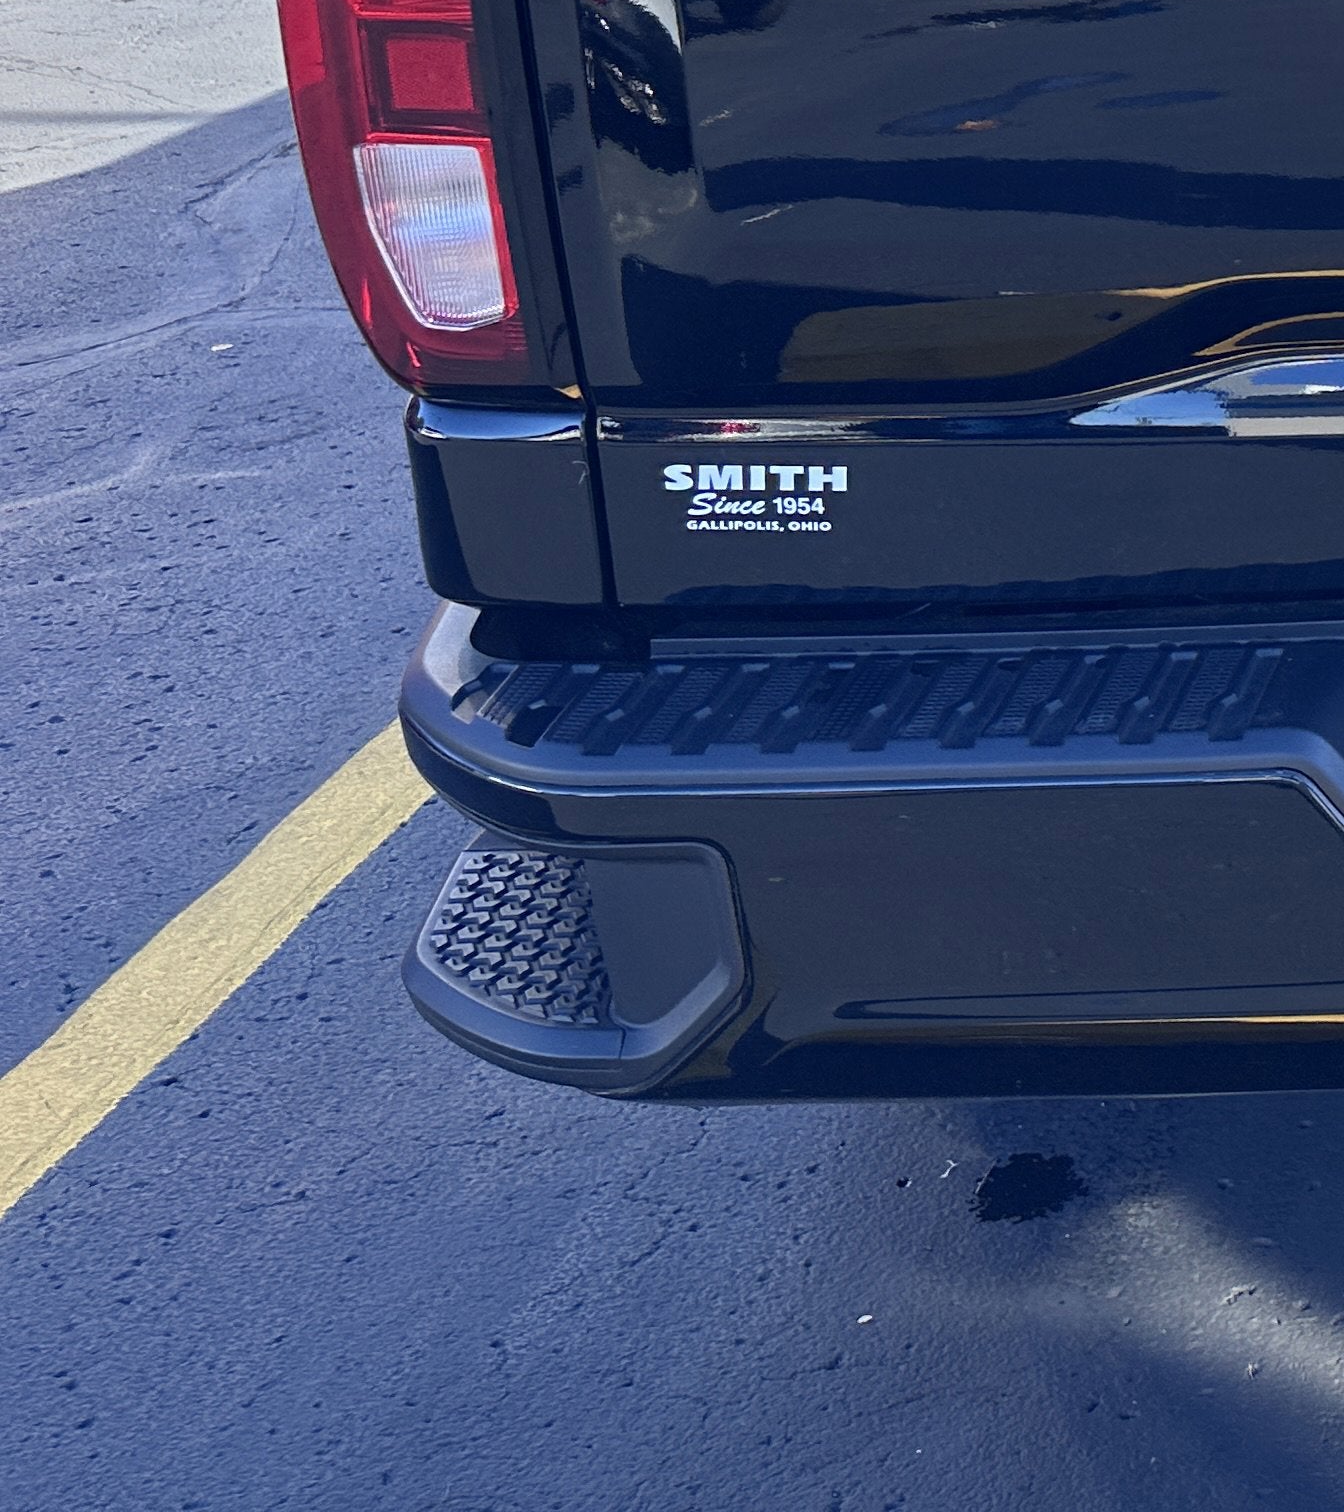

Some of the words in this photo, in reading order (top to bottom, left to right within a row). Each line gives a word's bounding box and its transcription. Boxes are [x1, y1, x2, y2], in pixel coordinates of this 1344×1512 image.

[663, 464, 848, 492] SMITH
[687, 492, 766, 516] Since
[772, 497, 826, 515] 1954
[686, 520, 785, 532] GALLIPOLIS,
[788, 521, 832, 532] OHIO
